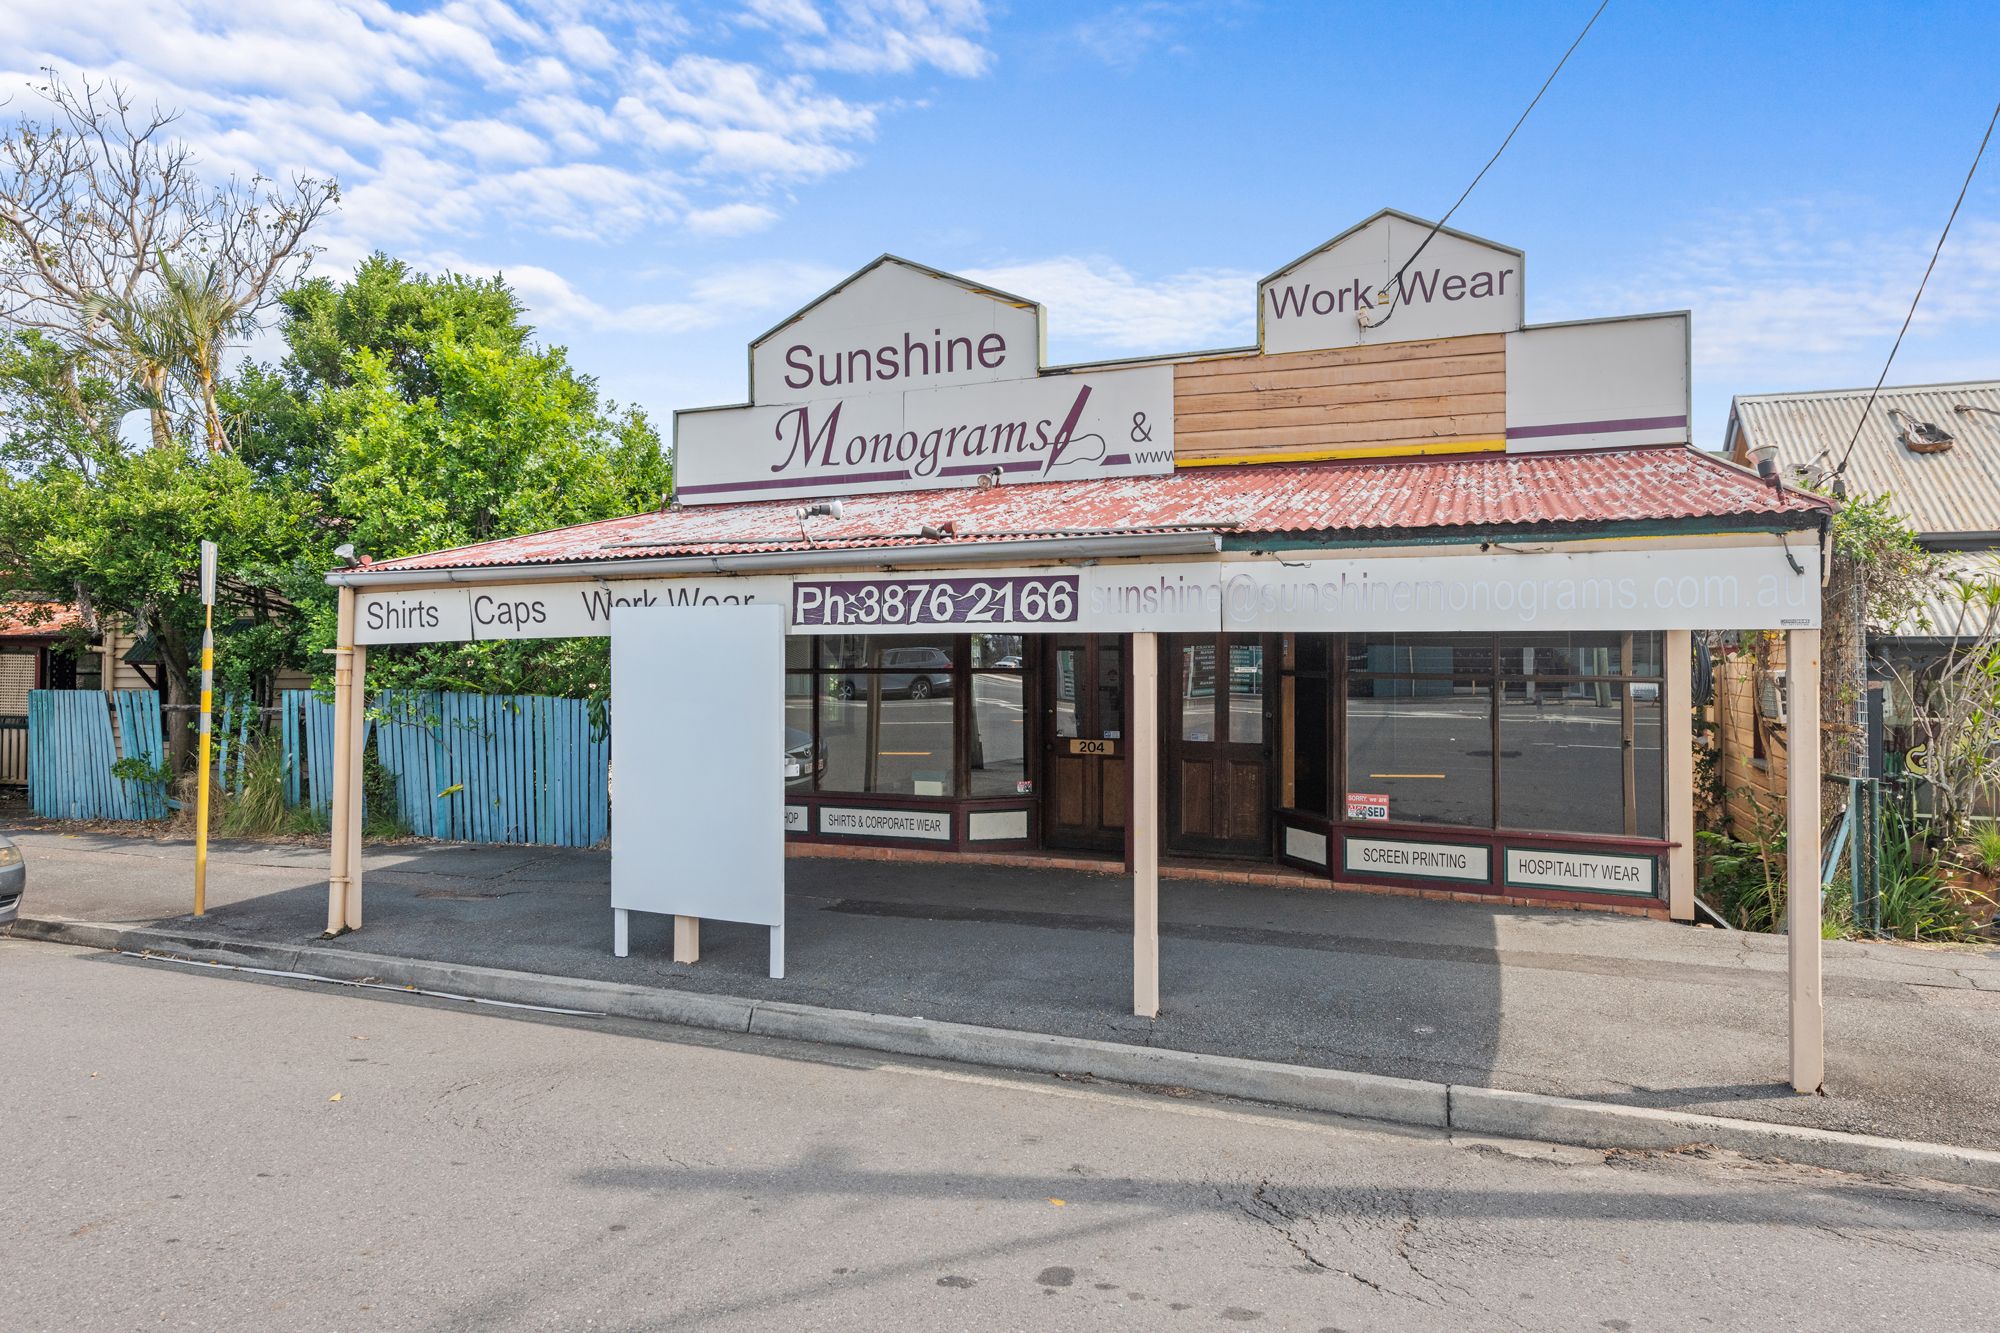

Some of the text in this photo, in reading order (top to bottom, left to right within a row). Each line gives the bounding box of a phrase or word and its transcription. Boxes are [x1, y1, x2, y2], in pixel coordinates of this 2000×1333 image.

[1269, 268, 1514, 320] Work Wear
[784, 328, 1007, 390] Sunshine
[770, 400, 1153, 478] Monograms &
[366, 600, 440, 631] Shirts
[474, 594, 547, 632] Caps
[964, 581, 1073, 624] 2166
[1079, 741, 1105, 753] 204
[828, 814, 942, 832] SHIRTS & CORPORATE WEAR
[1363, 847, 1467, 869] SCREEN PRINTING
[1519, 858, 1640, 882] HOSPITALITY WEAR
